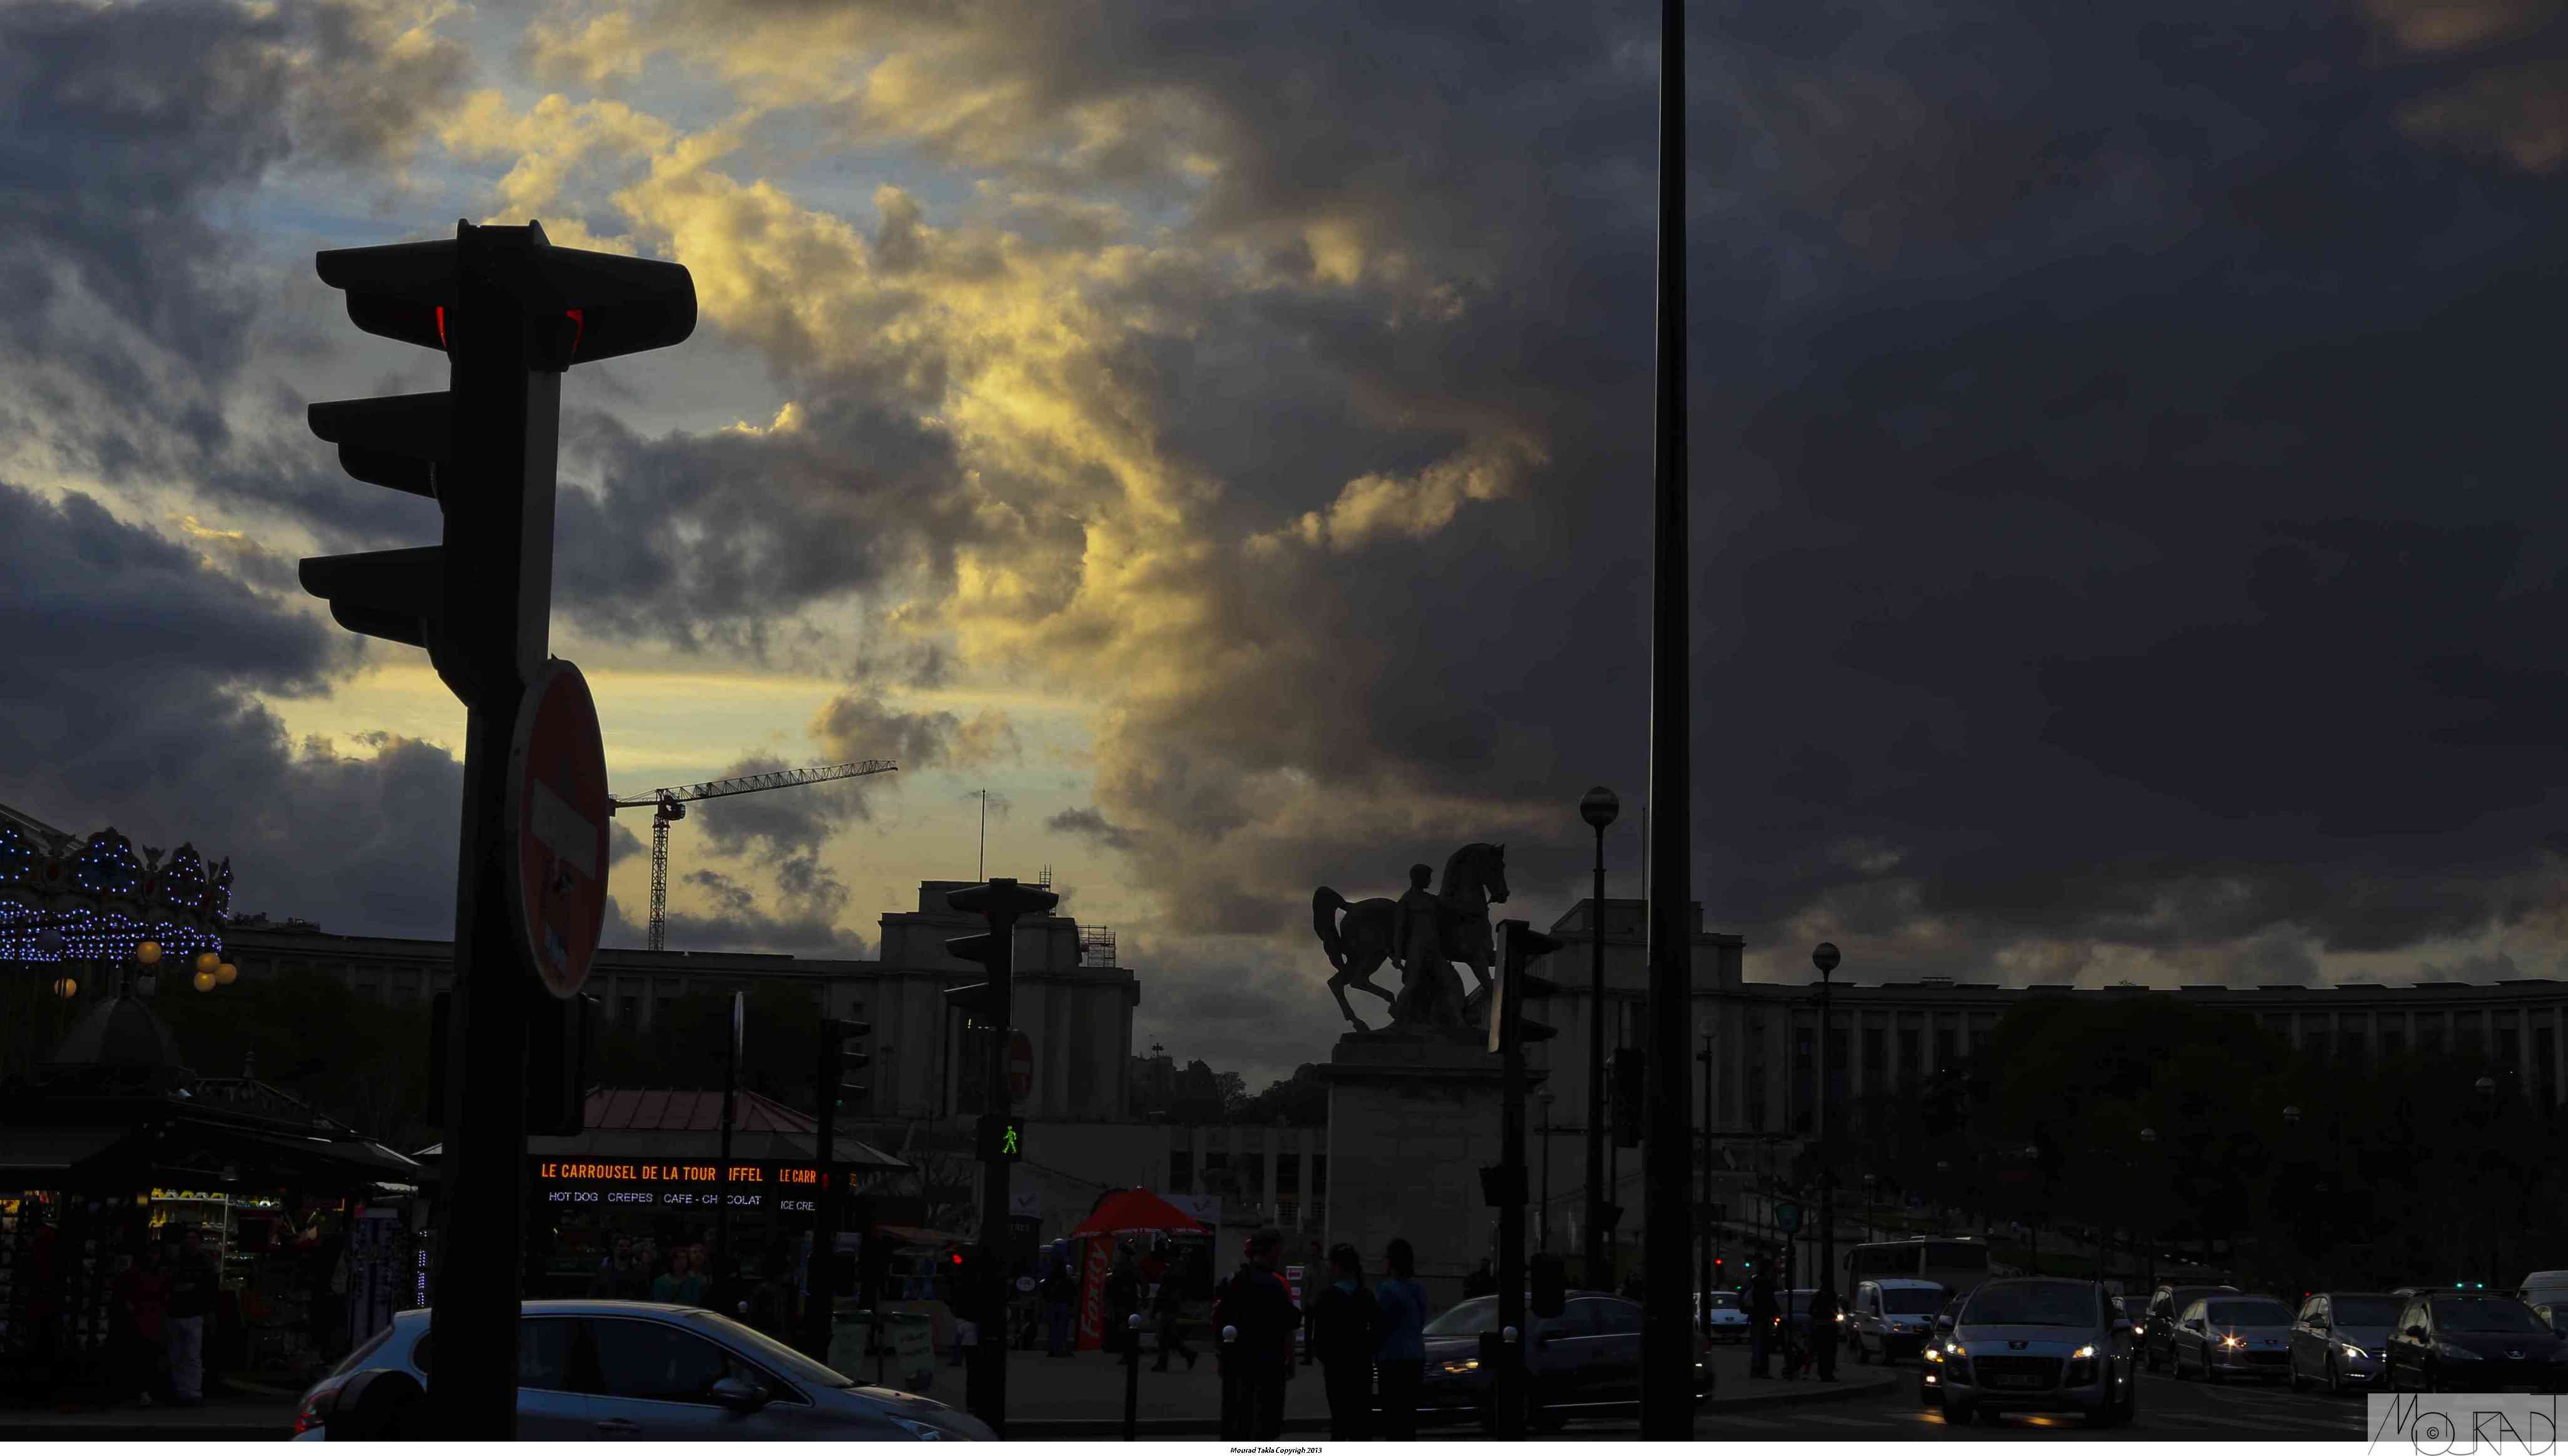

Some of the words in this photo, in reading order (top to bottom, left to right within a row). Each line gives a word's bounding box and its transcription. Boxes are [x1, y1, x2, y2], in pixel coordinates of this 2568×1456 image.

[541, 1164, 556, 1178] LE
[562, 1164, 636, 1179] CARROUSEL
[642, 1166, 657, 1179] DE
[663, 1166, 678, 1180] LA
[683, 1166, 716, 1181] TOUR
[724, 1168, 763, 1181] IFFEL
[780, 1169, 790, 1182] LE
[792, 1169, 816, 1183] CARR
[549, 1192, 571, 1201] HOT
[574, 1192, 598, 1201] DOG
[608, 1193, 653, 1202] CREPES
[663, 1193, 693, 1203] CAFE
[702, 1194, 762, 1205] CHCOLAT
[781, 1200, 794, 1210] ICE
[797, 1201, 815, 1211] CRE
